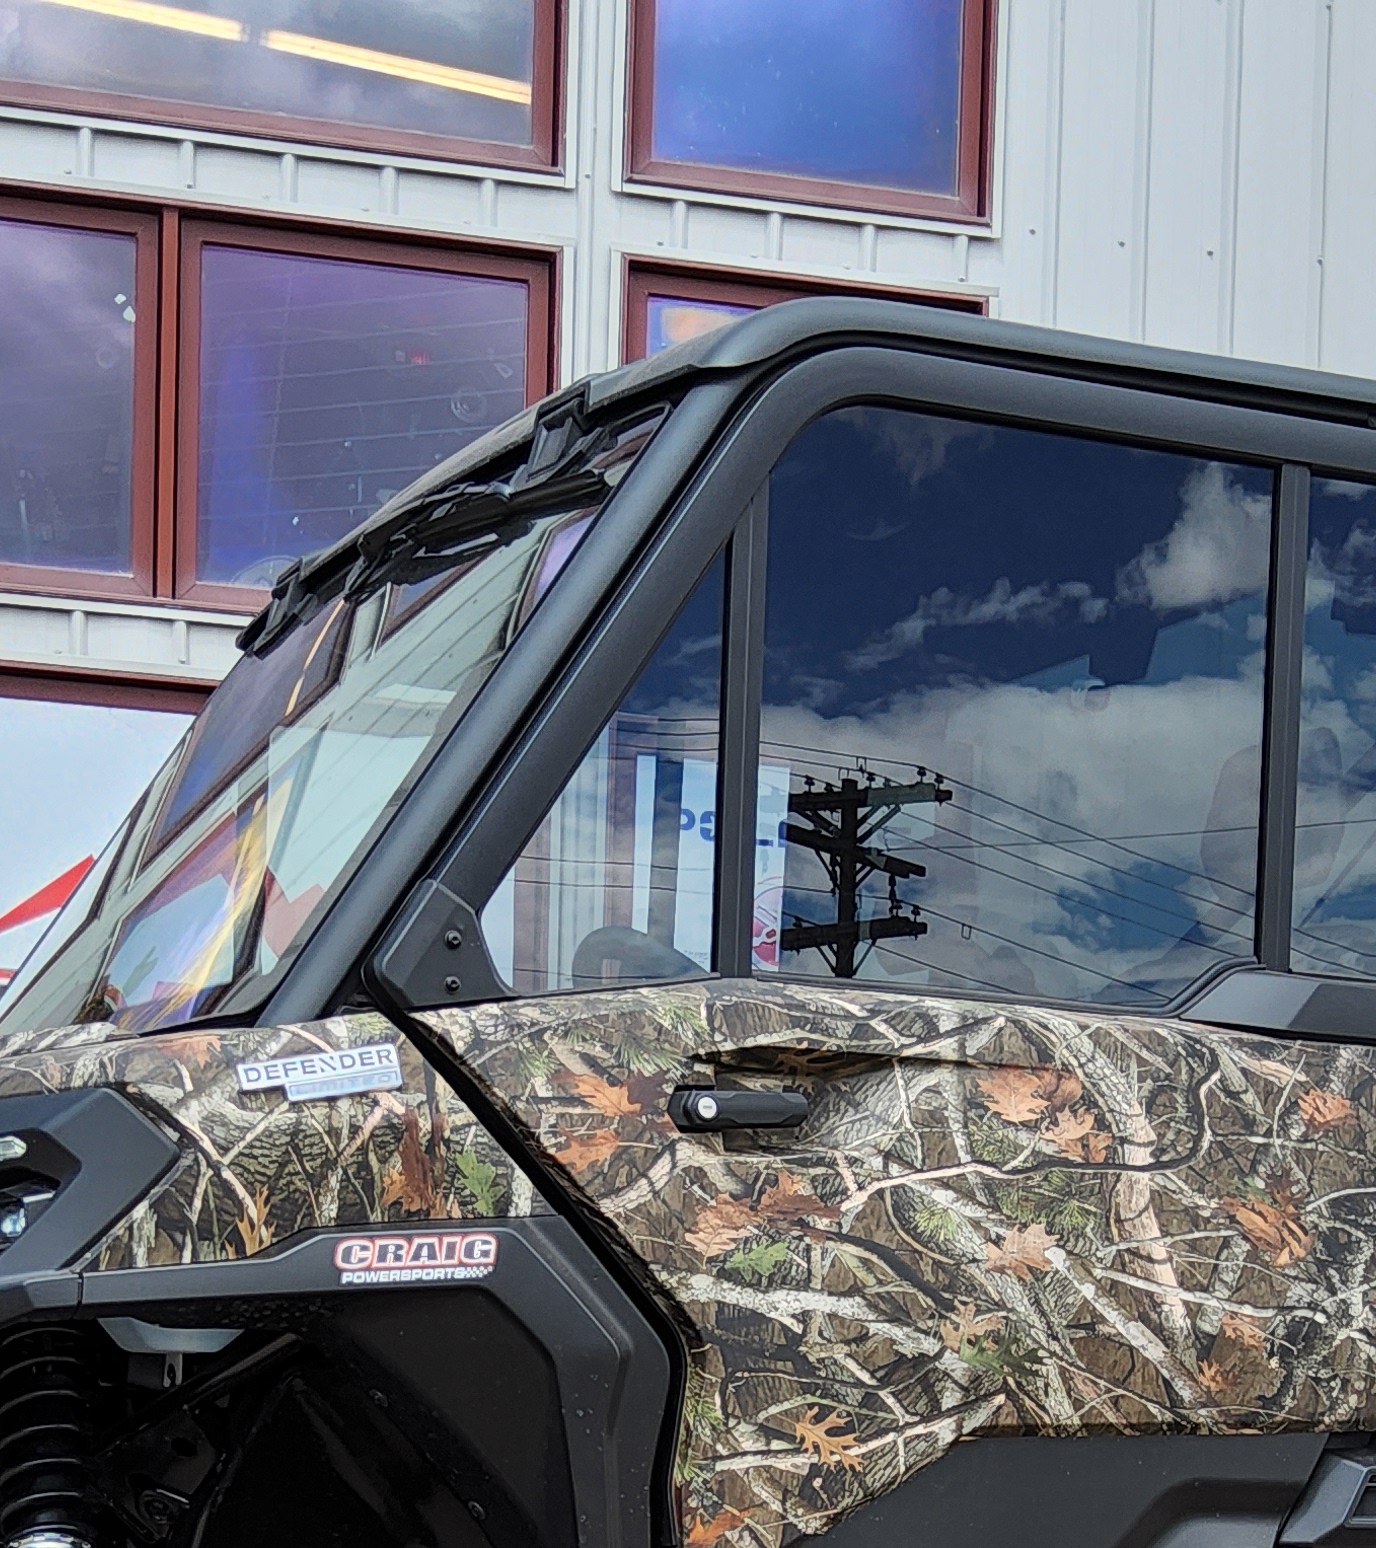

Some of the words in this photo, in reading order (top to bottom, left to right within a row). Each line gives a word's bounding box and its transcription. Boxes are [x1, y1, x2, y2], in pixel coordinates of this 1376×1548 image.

[243, 1048, 393, 1083] DEFENDER
[336, 1234, 496, 1268] CRAIG
[341, 1268, 465, 1284] POWERSPORTS
